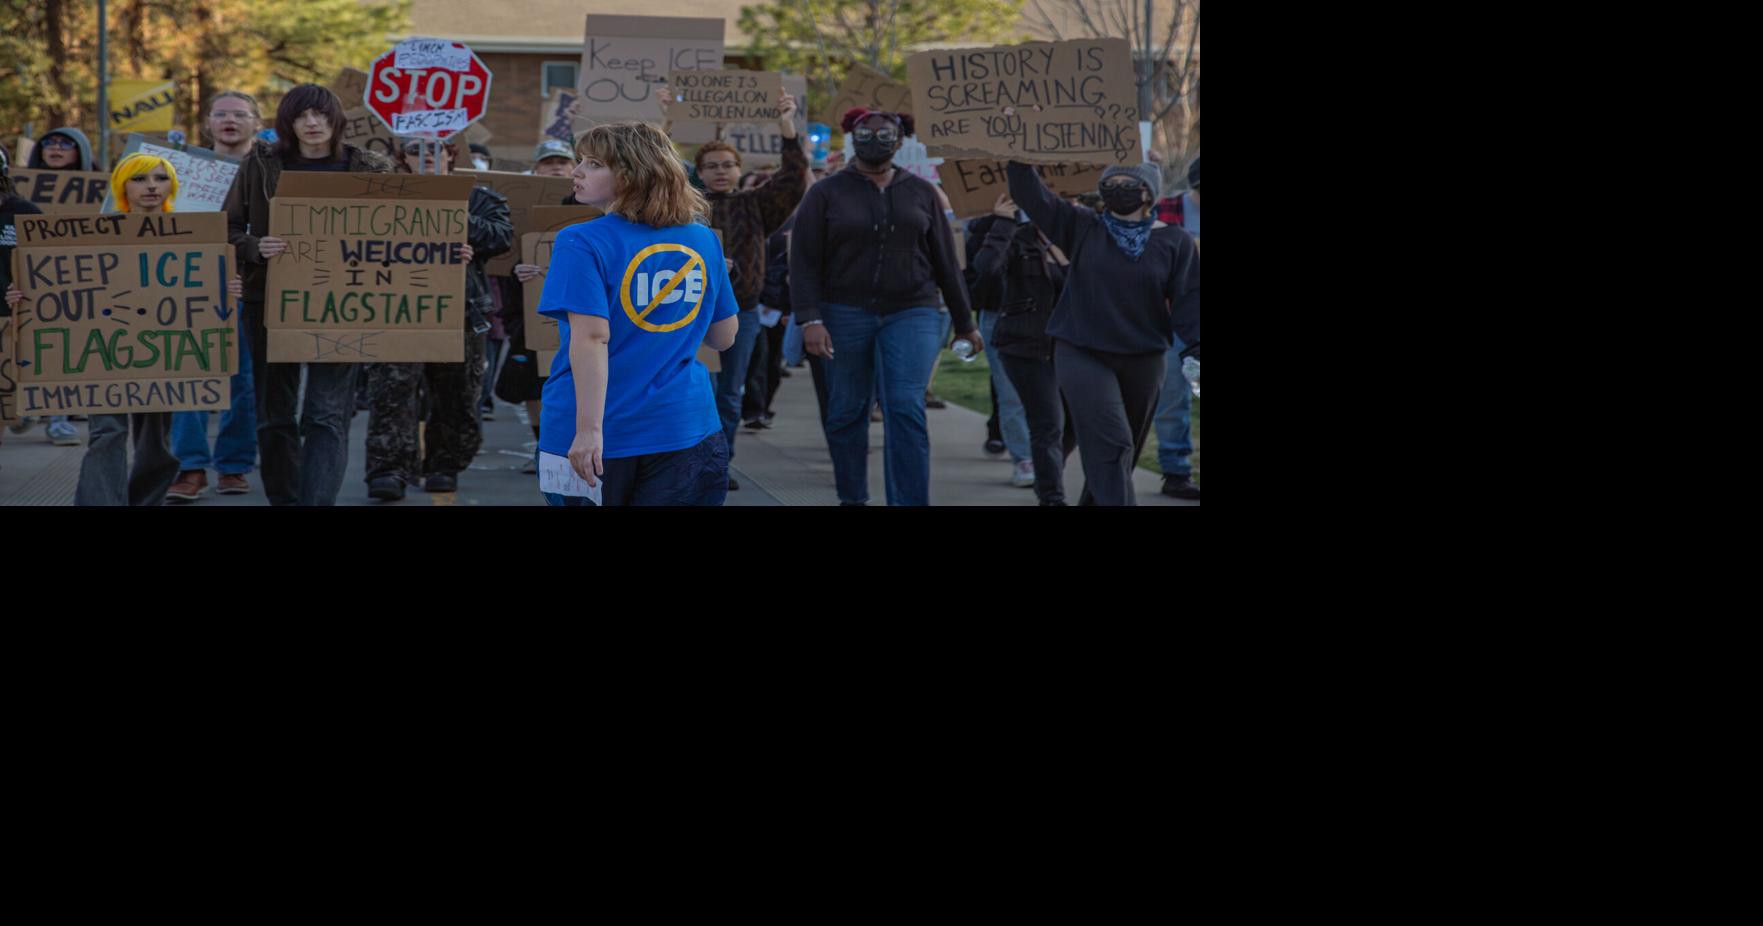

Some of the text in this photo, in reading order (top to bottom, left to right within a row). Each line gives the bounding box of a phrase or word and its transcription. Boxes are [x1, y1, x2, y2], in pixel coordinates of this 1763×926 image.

[590, 38, 717, 82] Keep ICE
[931, 47, 1104, 81] HISTORY IS
[375, 66, 482, 109] STOP
[585, 77, 668, 102] OU
[675, 75, 757, 88] NO ONE IS
[682, 89, 768, 103] ILLEGAL ON
[928, 76, 1107, 111] SCREAMING
[111, 90, 175, 124] NAU
[689, 104, 745, 119] STOLEN
[747, 107, 781, 119] LAND
[730, 134, 781, 154] ILLE
[931, 114, 1136, 153] ARE YOU LISTENING
[23, 215, 126, 241] PROTECT
[137, 217, 193, 238] ALL
[280, 203, 466, 237] IMMIGRANTS
[277, 240, 462, 264] ARE WELCOME
[26, 251, 204, 290] KEEP ICE
[636, 268, 703, 306] ICE
[36, 286, 210, 328] OUT OF
[281, 290, 454, 324] FLAGSTAFF
[33, 327, 235, 376] FLAGSTAFF
[23, 379, 222, 411] IMMIGRANTS
